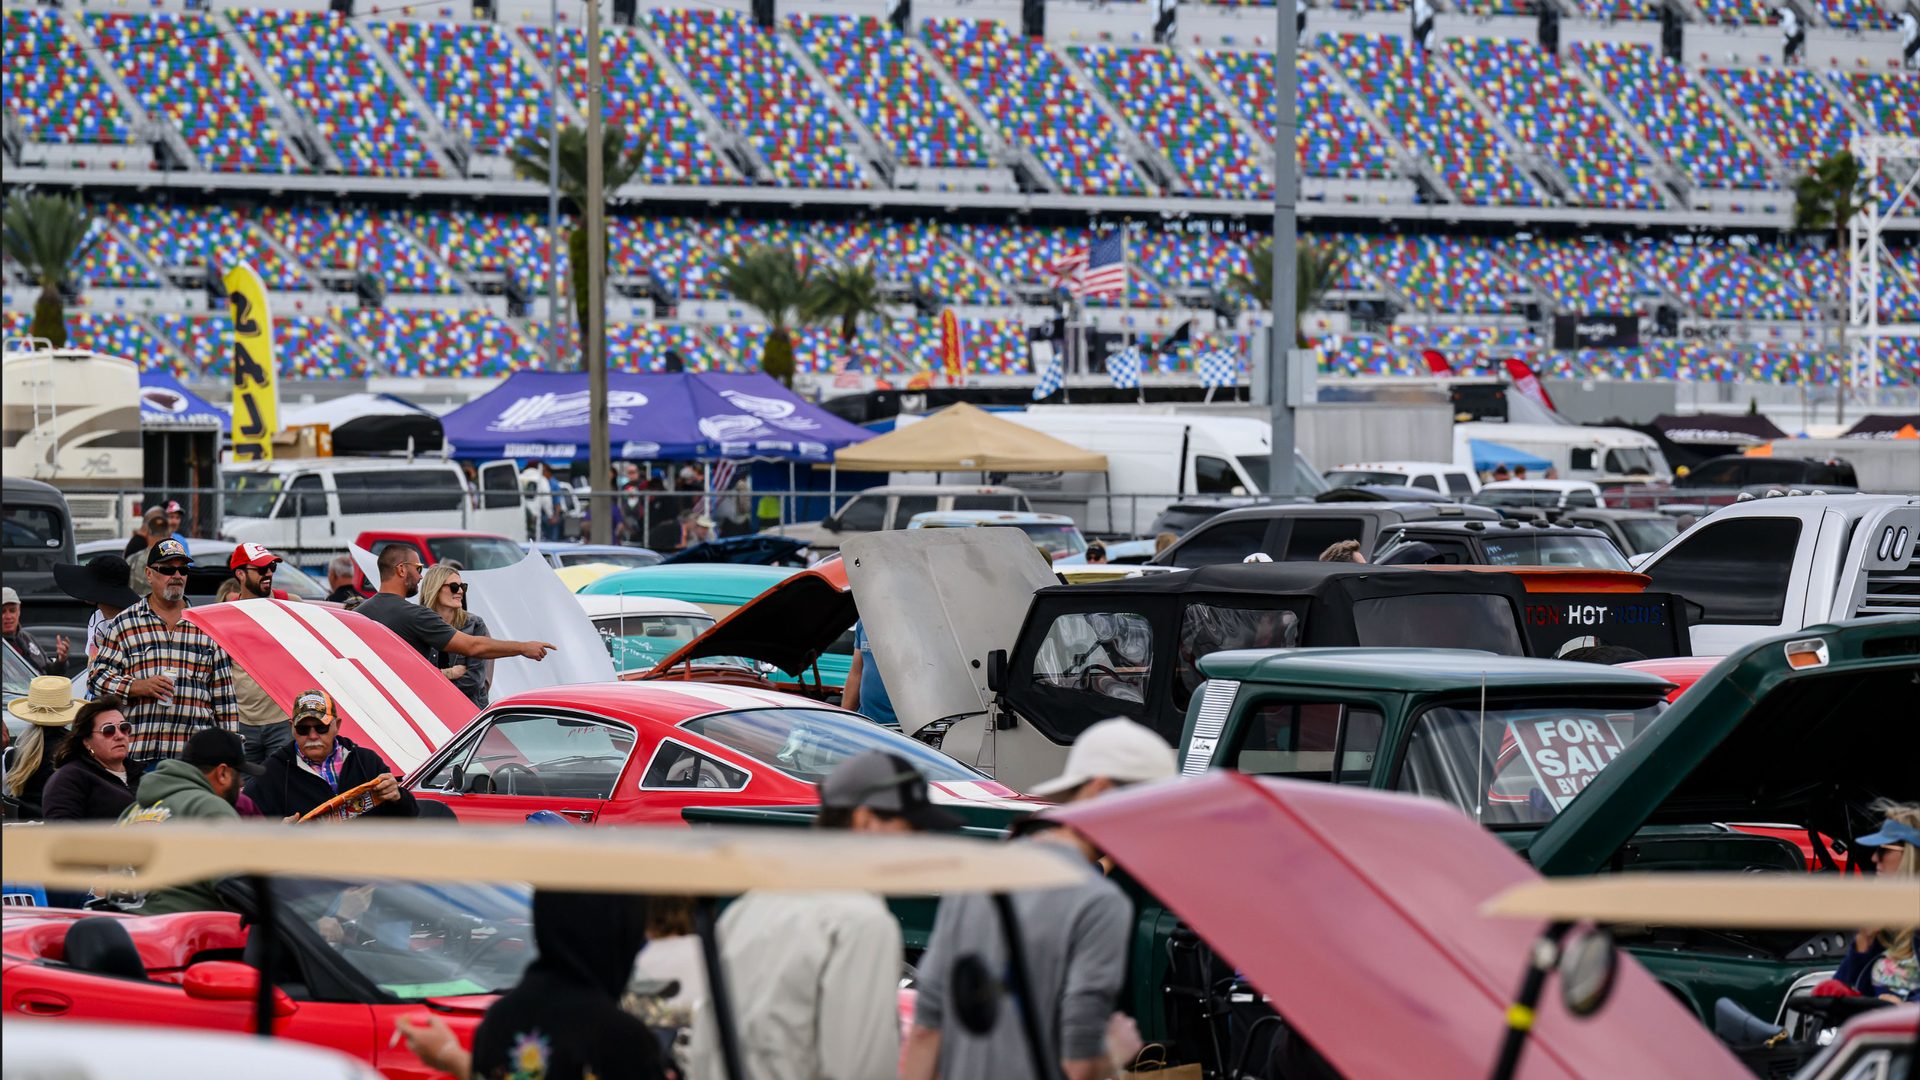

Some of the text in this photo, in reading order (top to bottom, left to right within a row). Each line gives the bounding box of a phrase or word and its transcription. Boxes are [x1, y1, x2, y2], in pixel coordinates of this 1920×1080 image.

[1568, 604, 1607, 625] HOT
[1534, 719, 1605, 746] FOR
[1555, 775, 1580, 794] BY
